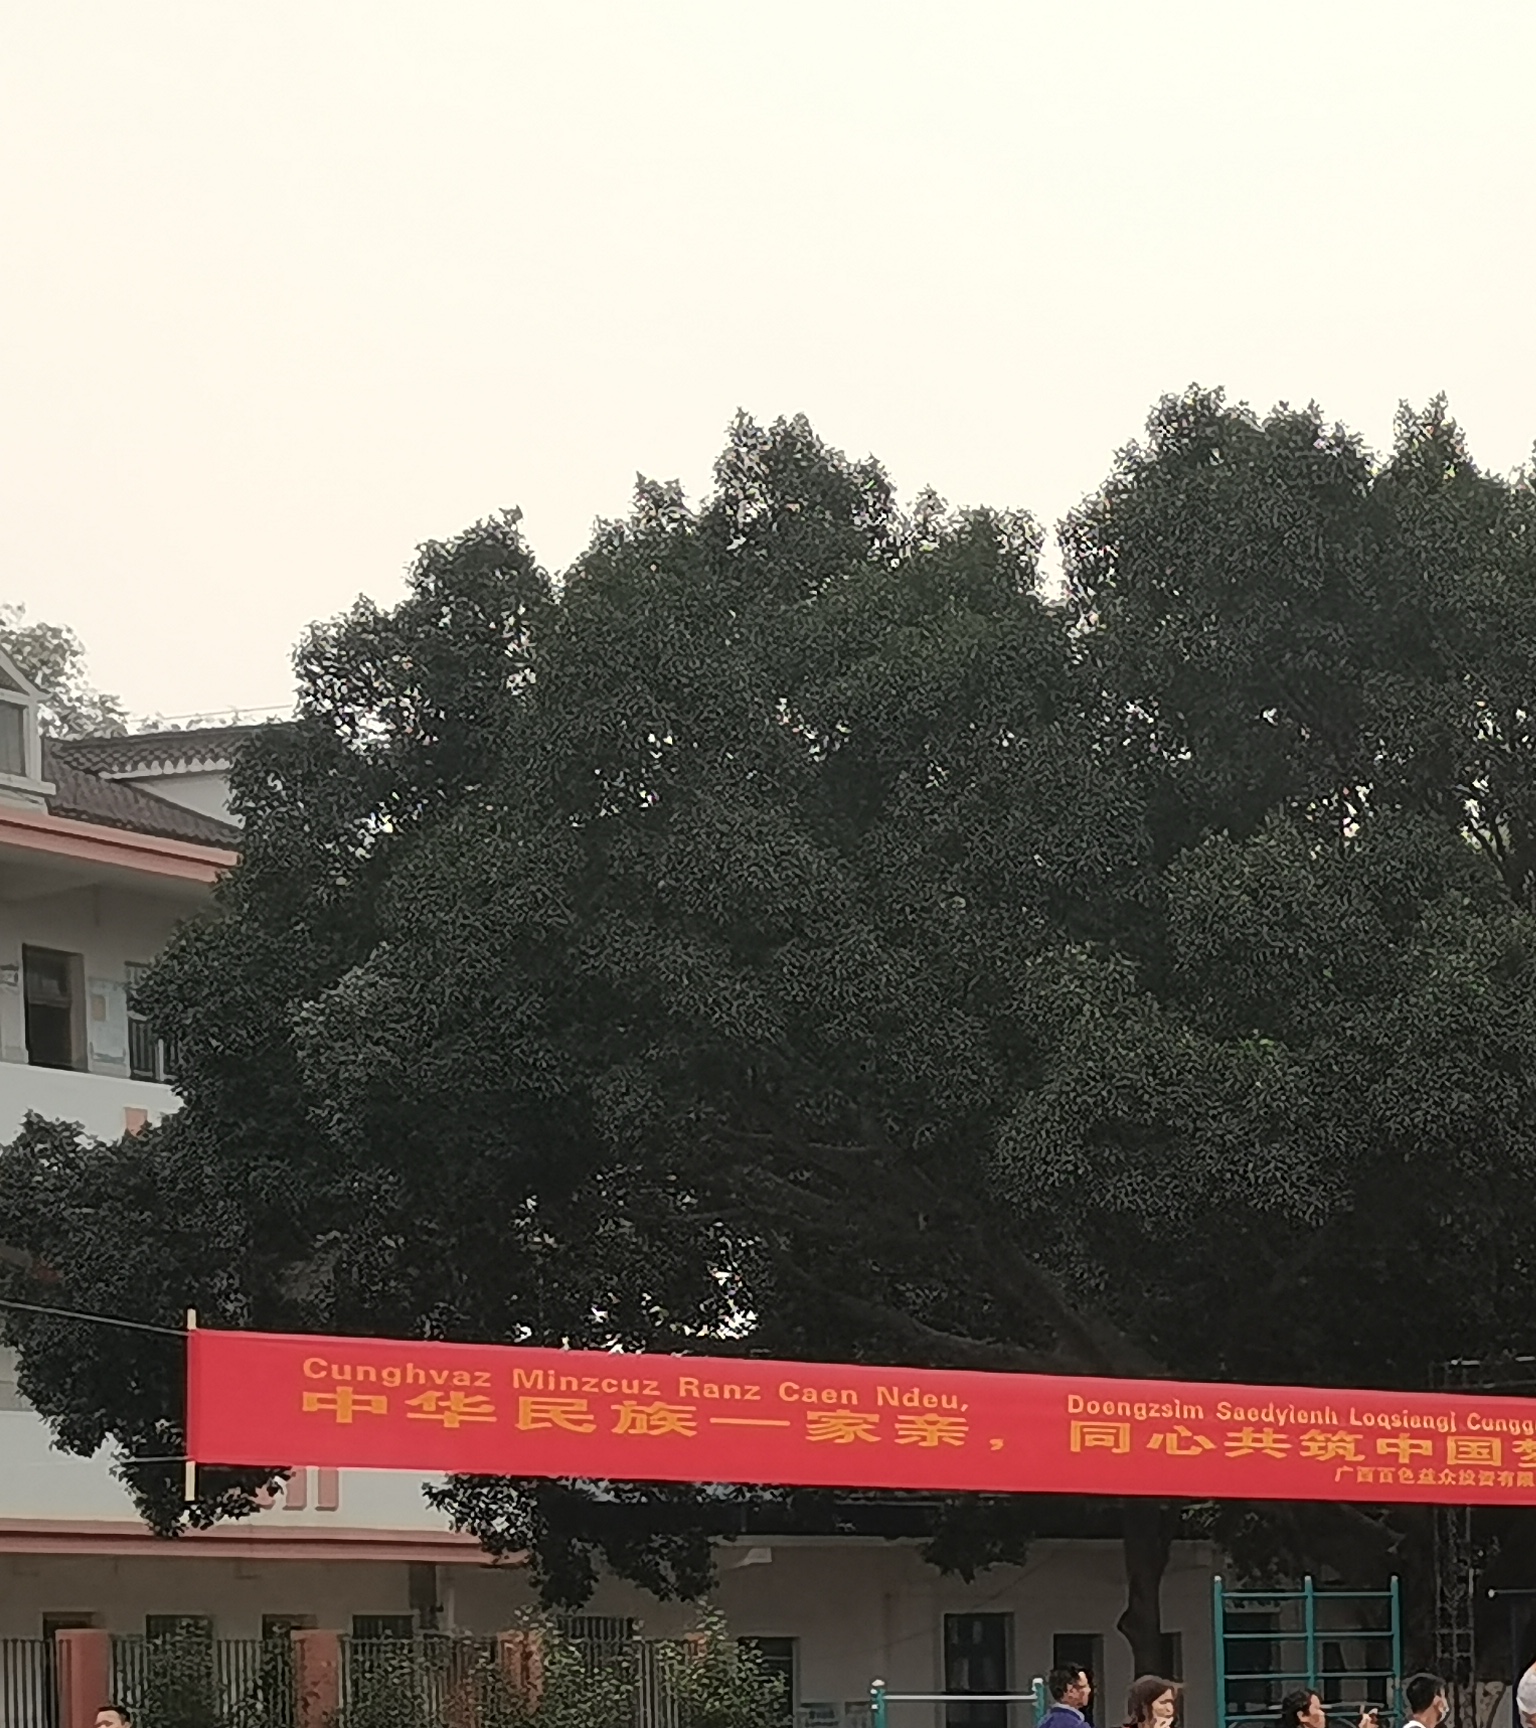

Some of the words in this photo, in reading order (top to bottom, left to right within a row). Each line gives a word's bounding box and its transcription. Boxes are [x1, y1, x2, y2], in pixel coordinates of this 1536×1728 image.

[302, 1357, 492, 1387] Cunghvaz
[512, 1368, 661, 1396] Minzcuz
[679, 1377, 761, 1400] Ranz
[778, 1381, 858, 1405] Caen
[1067, 1394, 1204, 1420] Doengzsim
